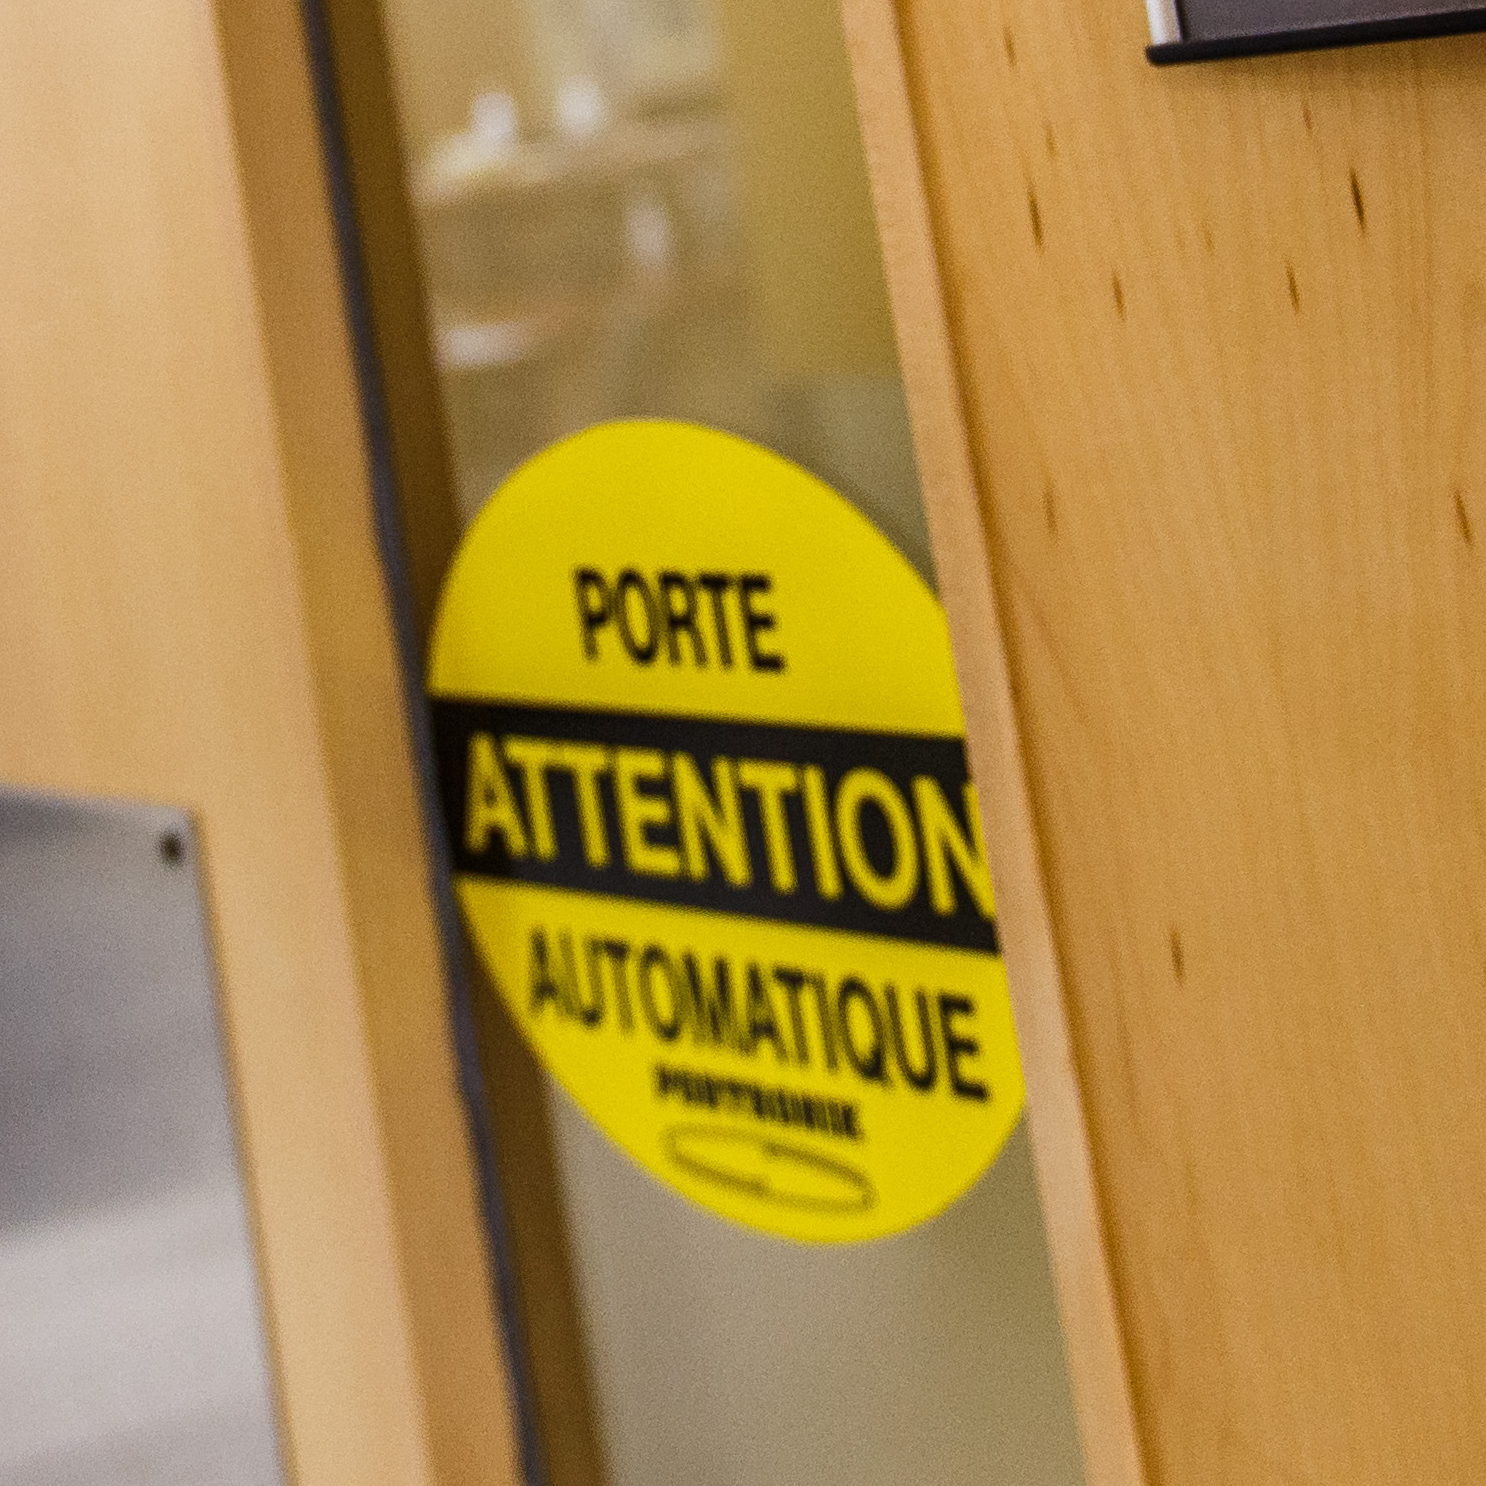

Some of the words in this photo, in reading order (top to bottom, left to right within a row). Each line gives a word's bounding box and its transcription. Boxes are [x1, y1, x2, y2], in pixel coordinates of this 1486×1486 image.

[572, 564, 789, 676] PORTE
[461, 728, 996, 922] ATTENTION
[526, 922, 994, 1106] AUTOMATIQUE
